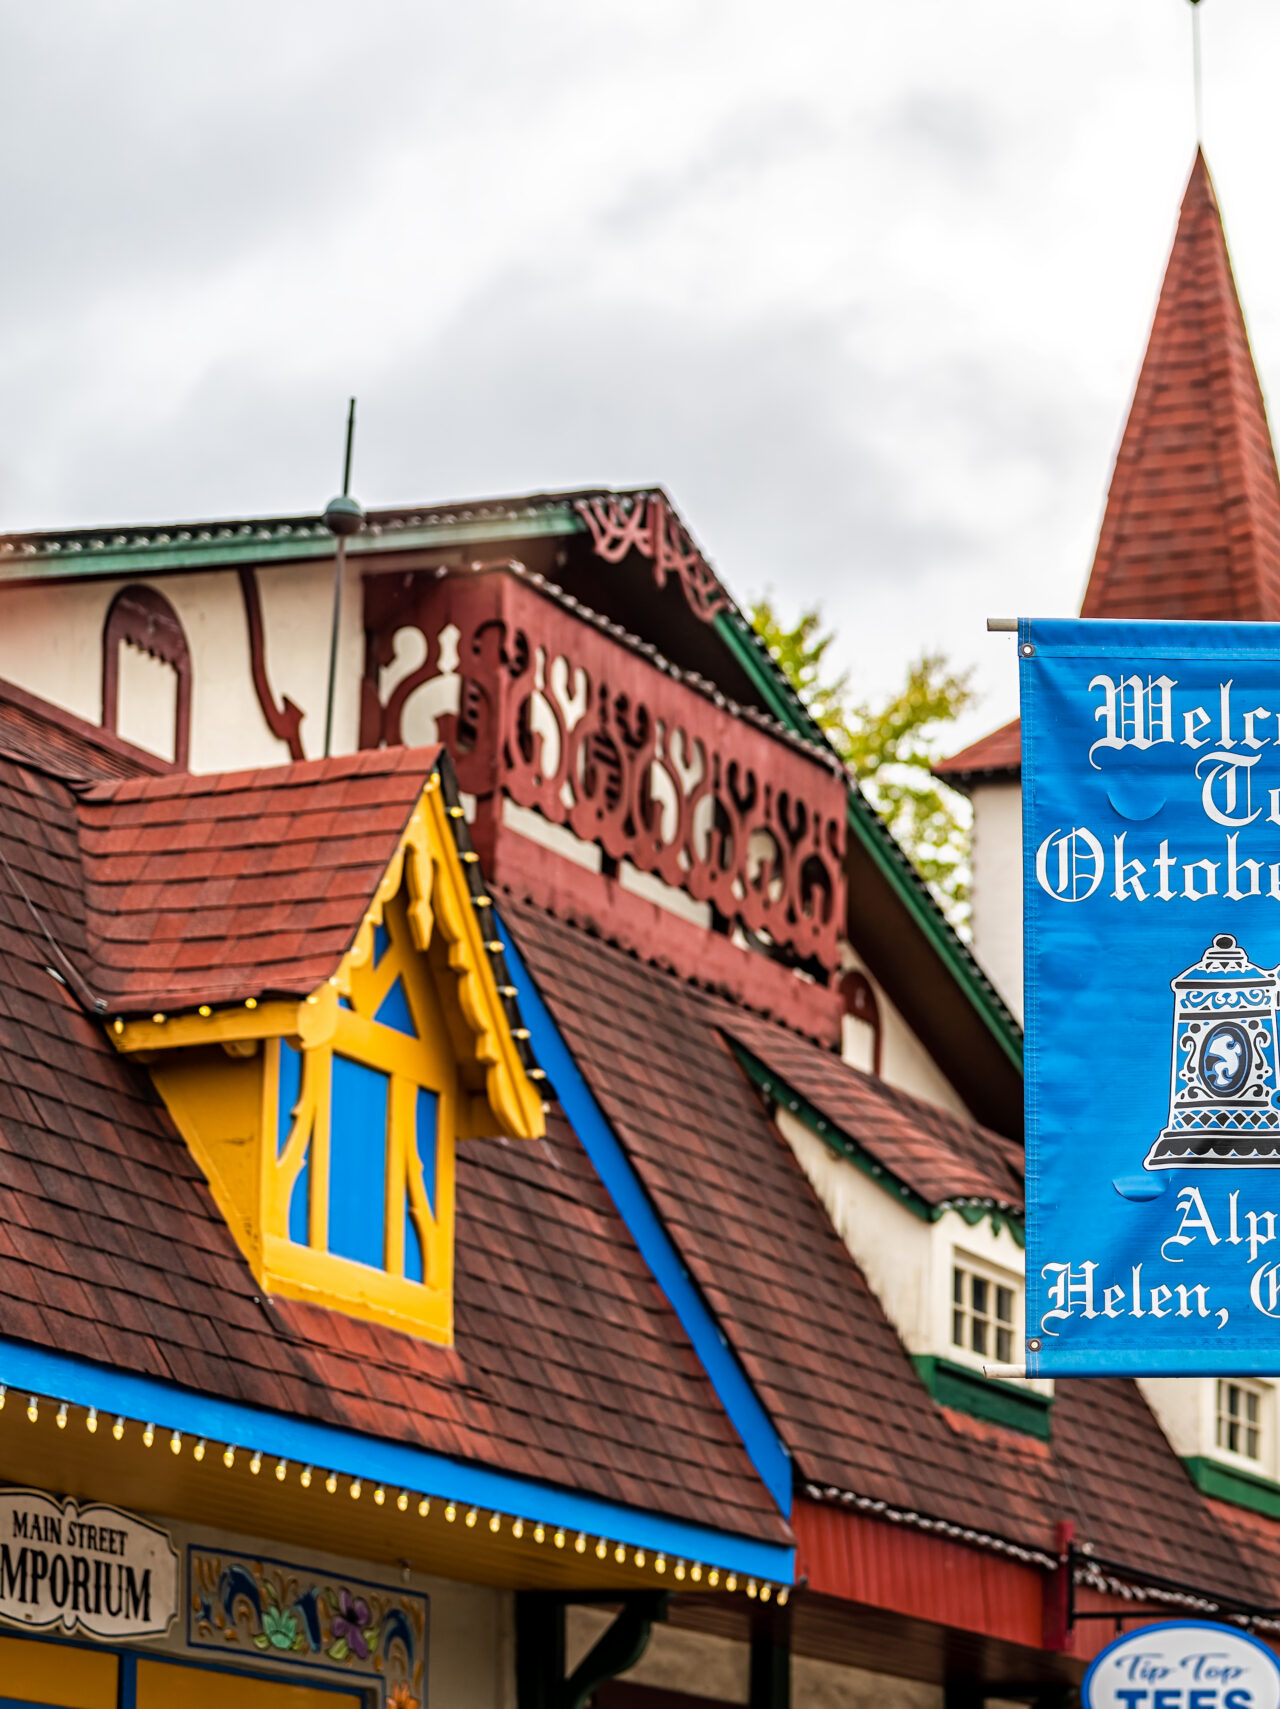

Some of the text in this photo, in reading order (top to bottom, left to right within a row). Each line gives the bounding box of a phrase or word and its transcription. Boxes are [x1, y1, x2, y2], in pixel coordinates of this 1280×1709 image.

[1041, 1259, 1229, 1337] Helen,
[12, 1510, 128, 1556] MAIN STREET
[1114, 1653, 1247, 1685] Tip Top
